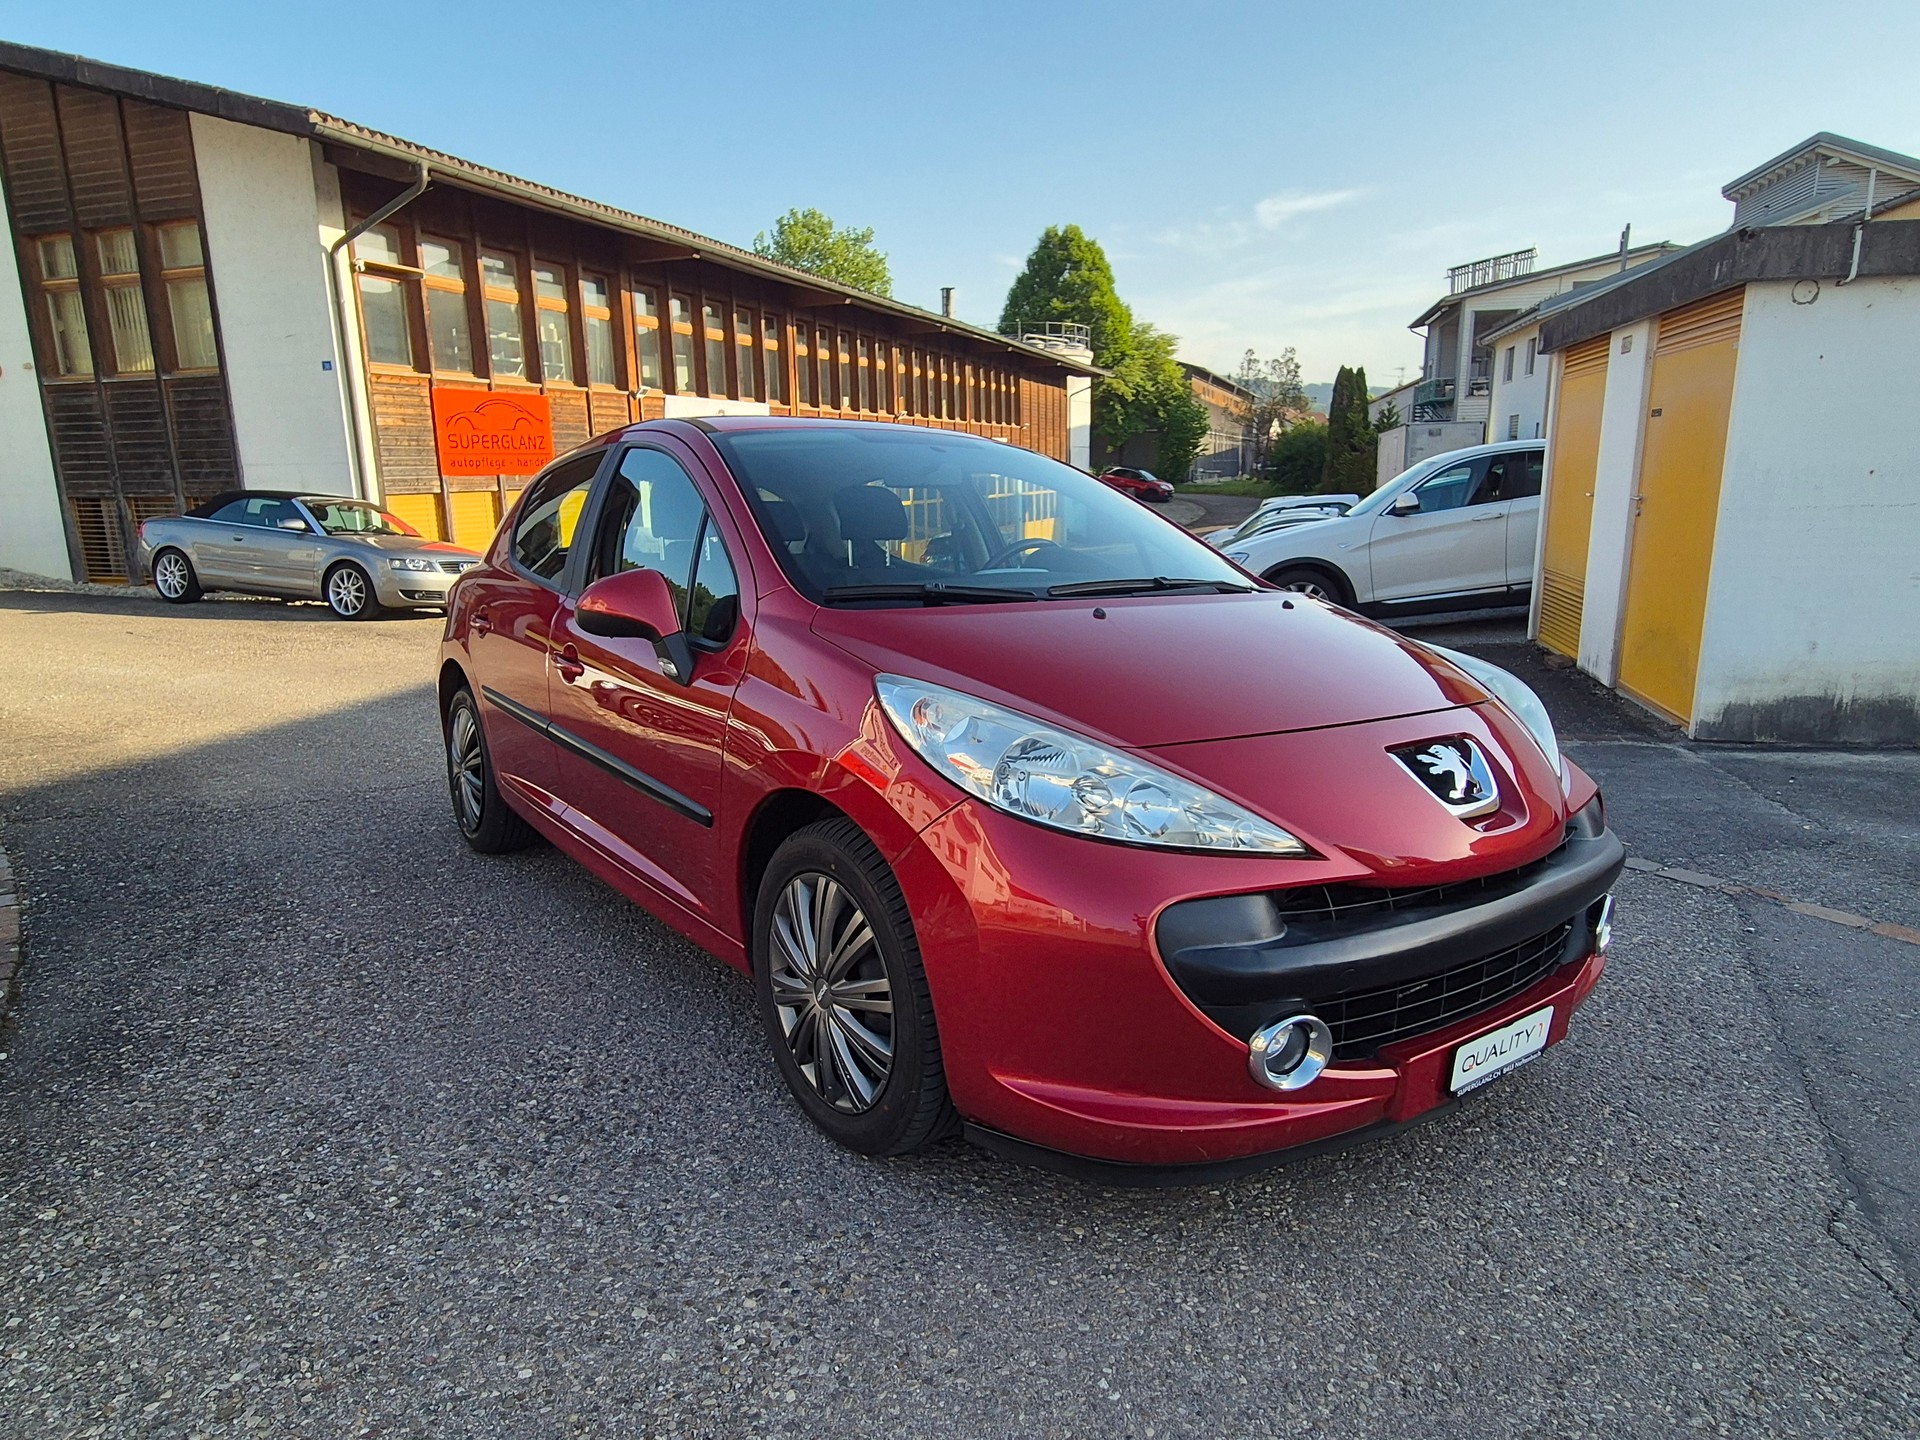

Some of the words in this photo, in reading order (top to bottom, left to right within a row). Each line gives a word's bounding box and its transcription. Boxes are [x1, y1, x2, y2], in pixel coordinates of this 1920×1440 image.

[448, 434, 545, 450] SUPERGLANZ
[450, 458, 505, 469] autopflege
[1461, 1025, 1536, 1074] QUALITY
